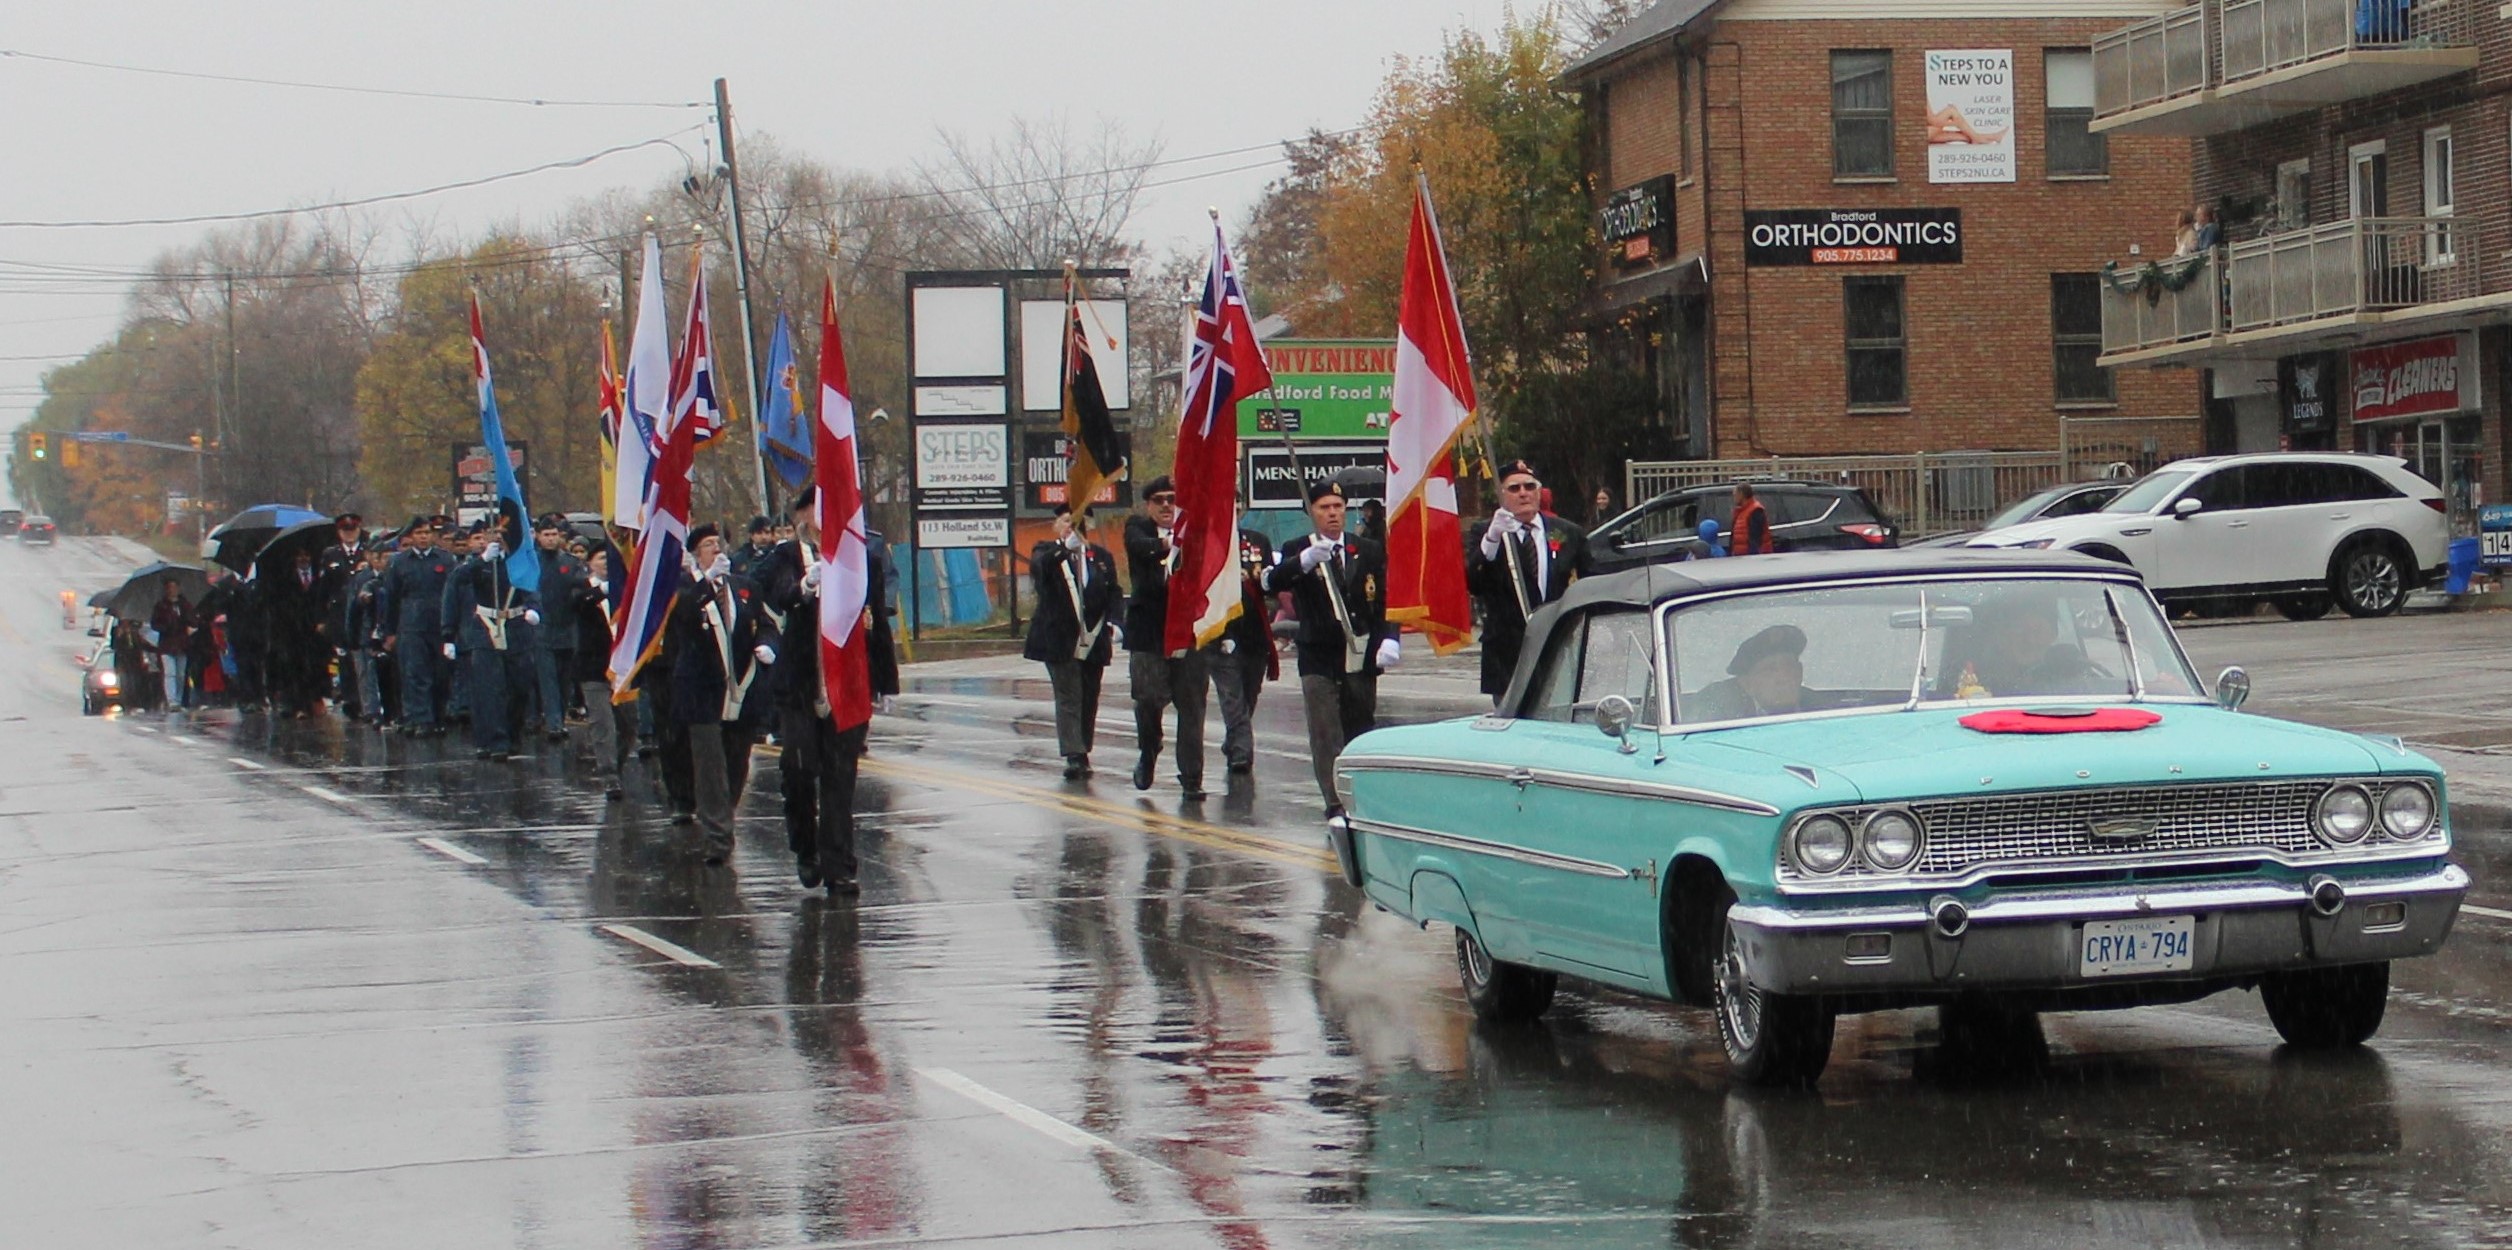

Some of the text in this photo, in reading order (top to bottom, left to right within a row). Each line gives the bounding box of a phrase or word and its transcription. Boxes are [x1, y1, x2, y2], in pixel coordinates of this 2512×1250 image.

[1929, 54, 2009, 71] STEPS TO A
[1938, 73, 2004, 86] NEW YOU
[1973, 96, 2002, 104] LASER
[1964, 107, 2011, 115] SKIN CARE
[1973, 119, 2003, 127] CLINIC
[1937, 153, 2007, 164] 289-926-0460
[1937, 168, 2006, 178] STEPS2NU.CA
[1830, 212, 1877, 222] Bradford
[1751, 222, 1957, 247] ORTHODONTICS
[1816, 250, 1894, 262] 905.775.1234
[2386, 356, 2458, 406] CLEANERS
[1329, 386, 1372, 400] Food
[2293, 402, 2324, 419] LEGENDS
[922, 430, 1001, 463] STEPS
[929, 473, 996, 482] 289-926-0460
[922, 522, 939, 533] 113
[942, 521, 979, 533] Holland
[2086, 931, 2188, 962] CRYA 794
